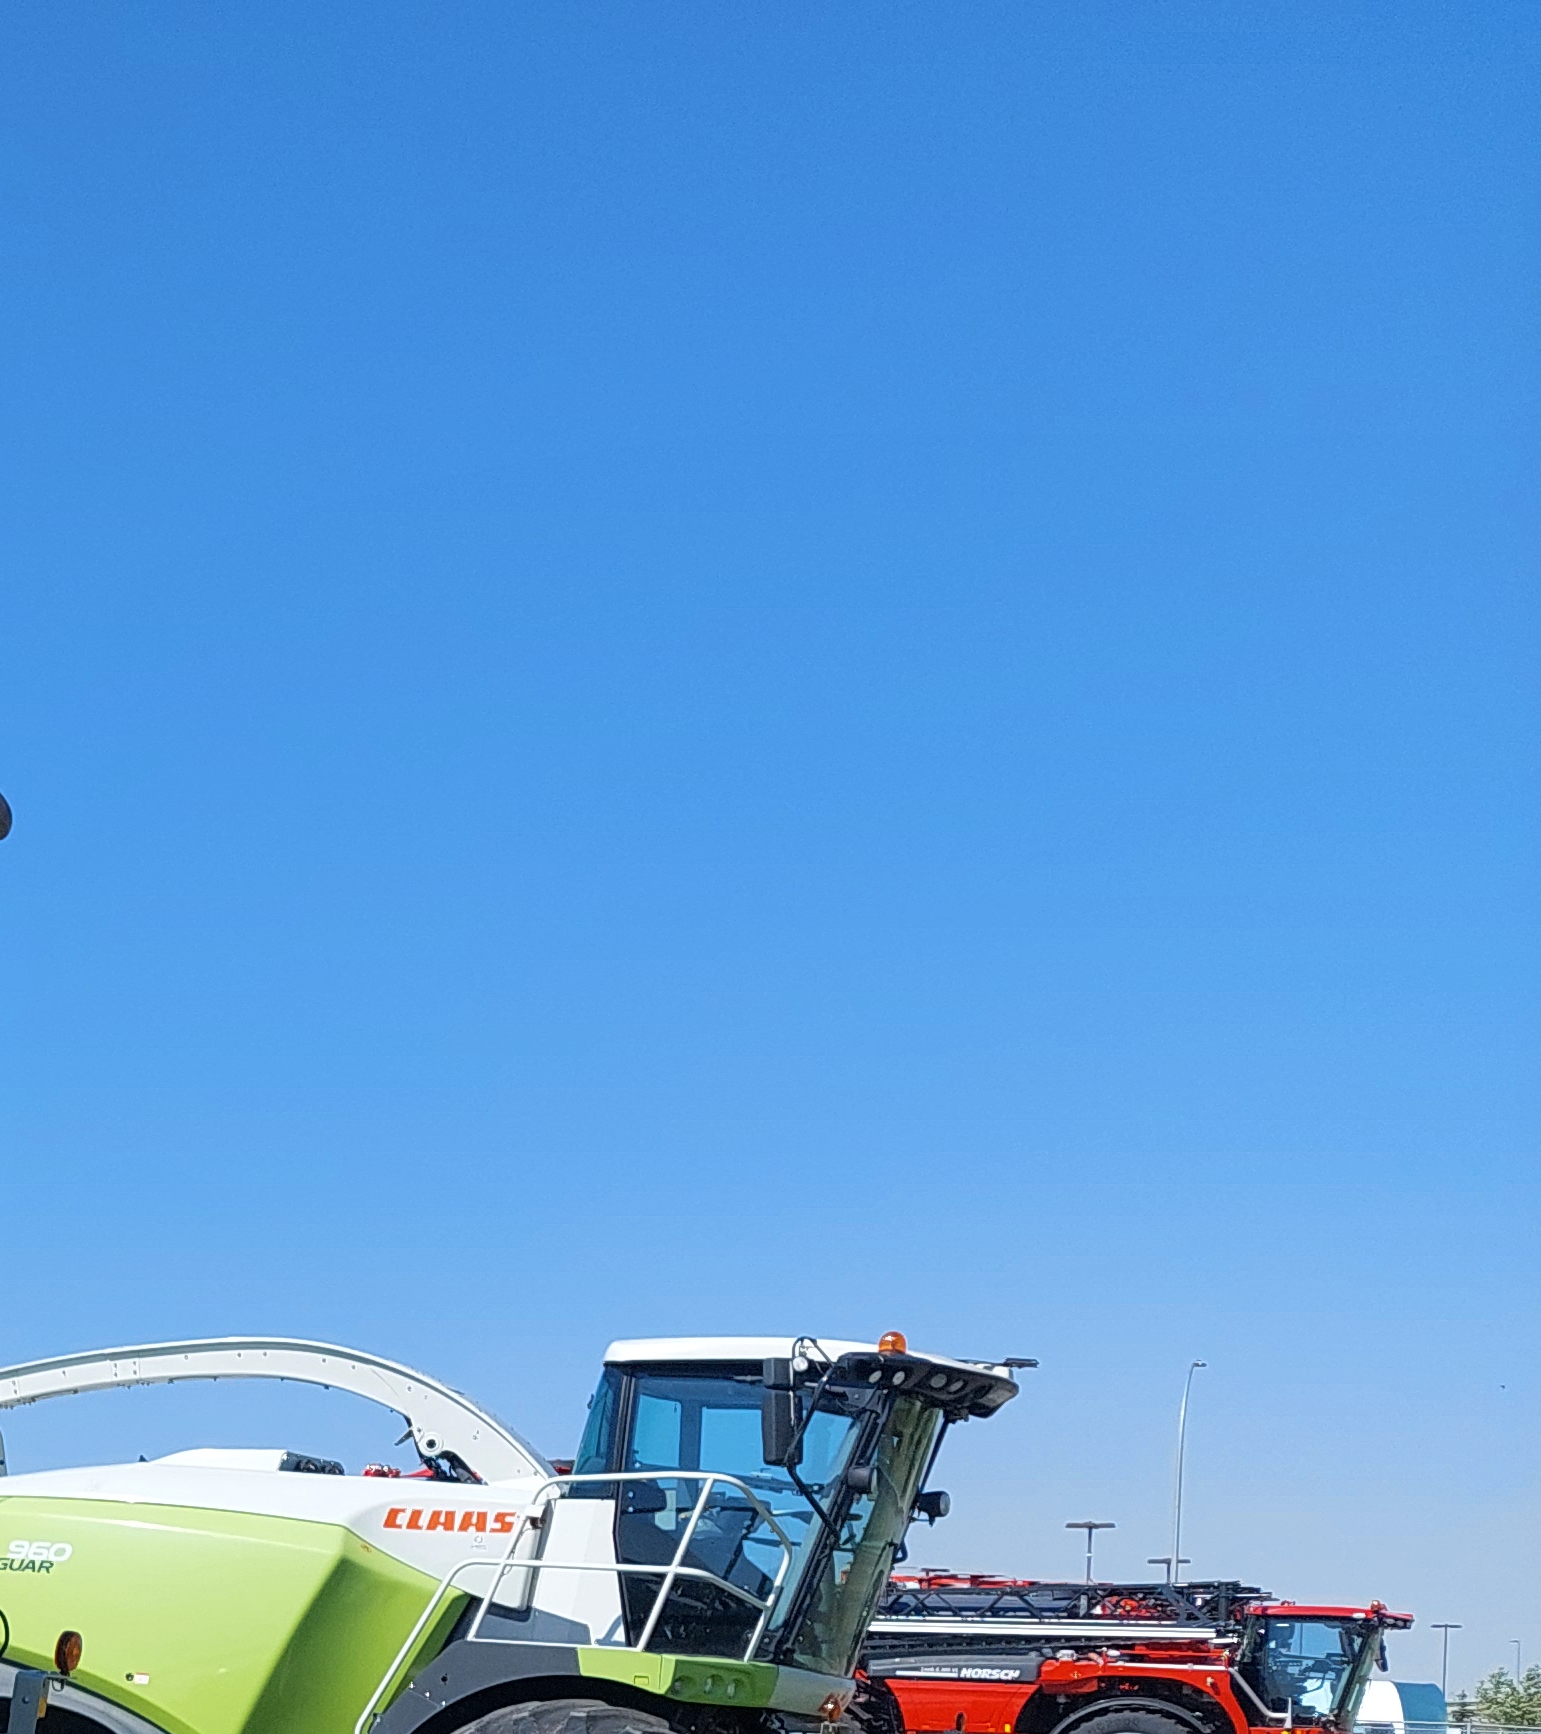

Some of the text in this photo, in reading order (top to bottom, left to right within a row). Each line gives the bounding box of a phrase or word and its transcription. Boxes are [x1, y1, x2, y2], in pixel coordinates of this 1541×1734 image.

[383, 1507, 516, 1533] CLAAS
[7, 1540, 73, 1562] 960
[960, 1667, 1020, 1680] HORSCH
